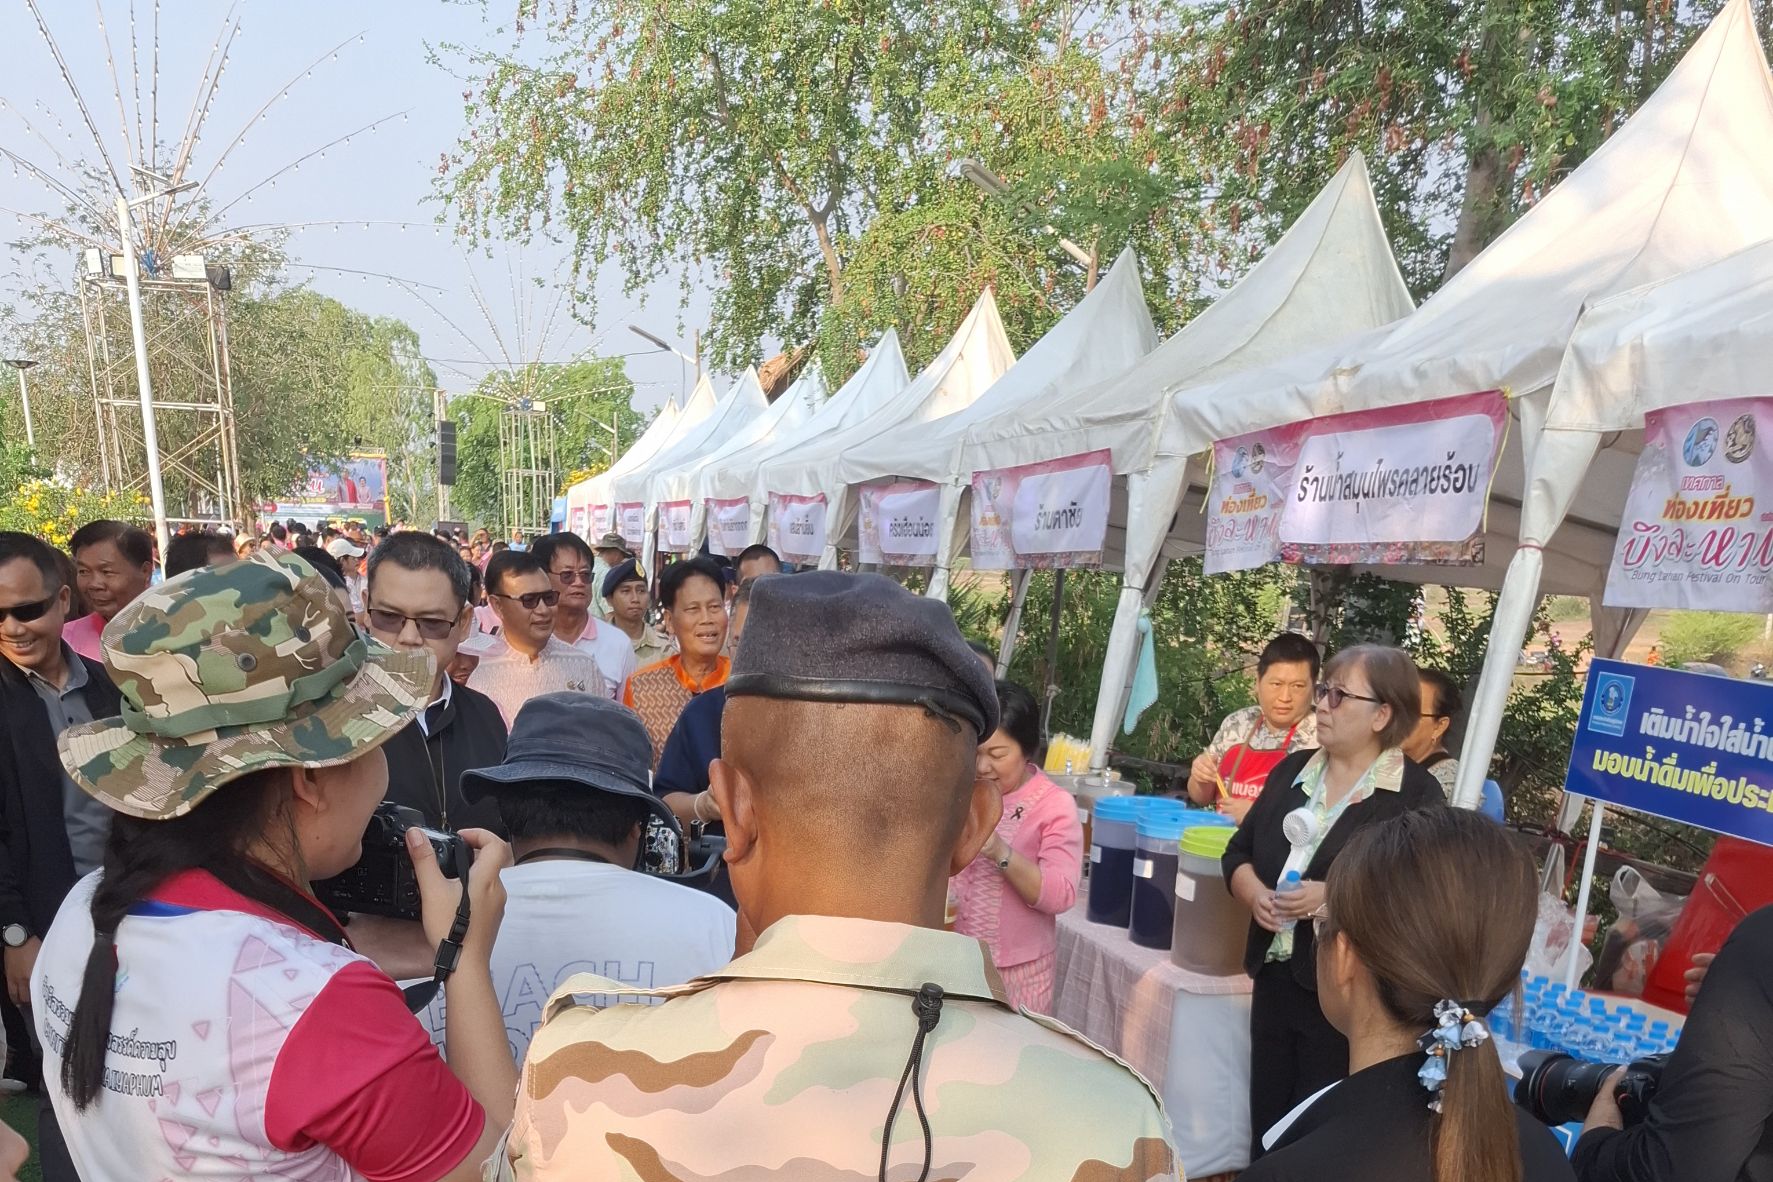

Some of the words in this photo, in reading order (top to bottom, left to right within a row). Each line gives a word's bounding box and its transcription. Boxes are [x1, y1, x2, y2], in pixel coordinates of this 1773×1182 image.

[1681, 475, 1724, 491] เทศกาล
[1663, 485, 1755, 520] ท่องเที่ยว
[1631, 570, 1657, 584] Bung
[1686, 571, 1722, 584] Festival
[1725, 572, 1741, 584] On
[1745, 573, 1768, 585] Tour
[1592, 745, 1773, 814] มอบน้ำดื่มเพื่อประ
[102, 1065, 164, 1098] AIYAPHUM
